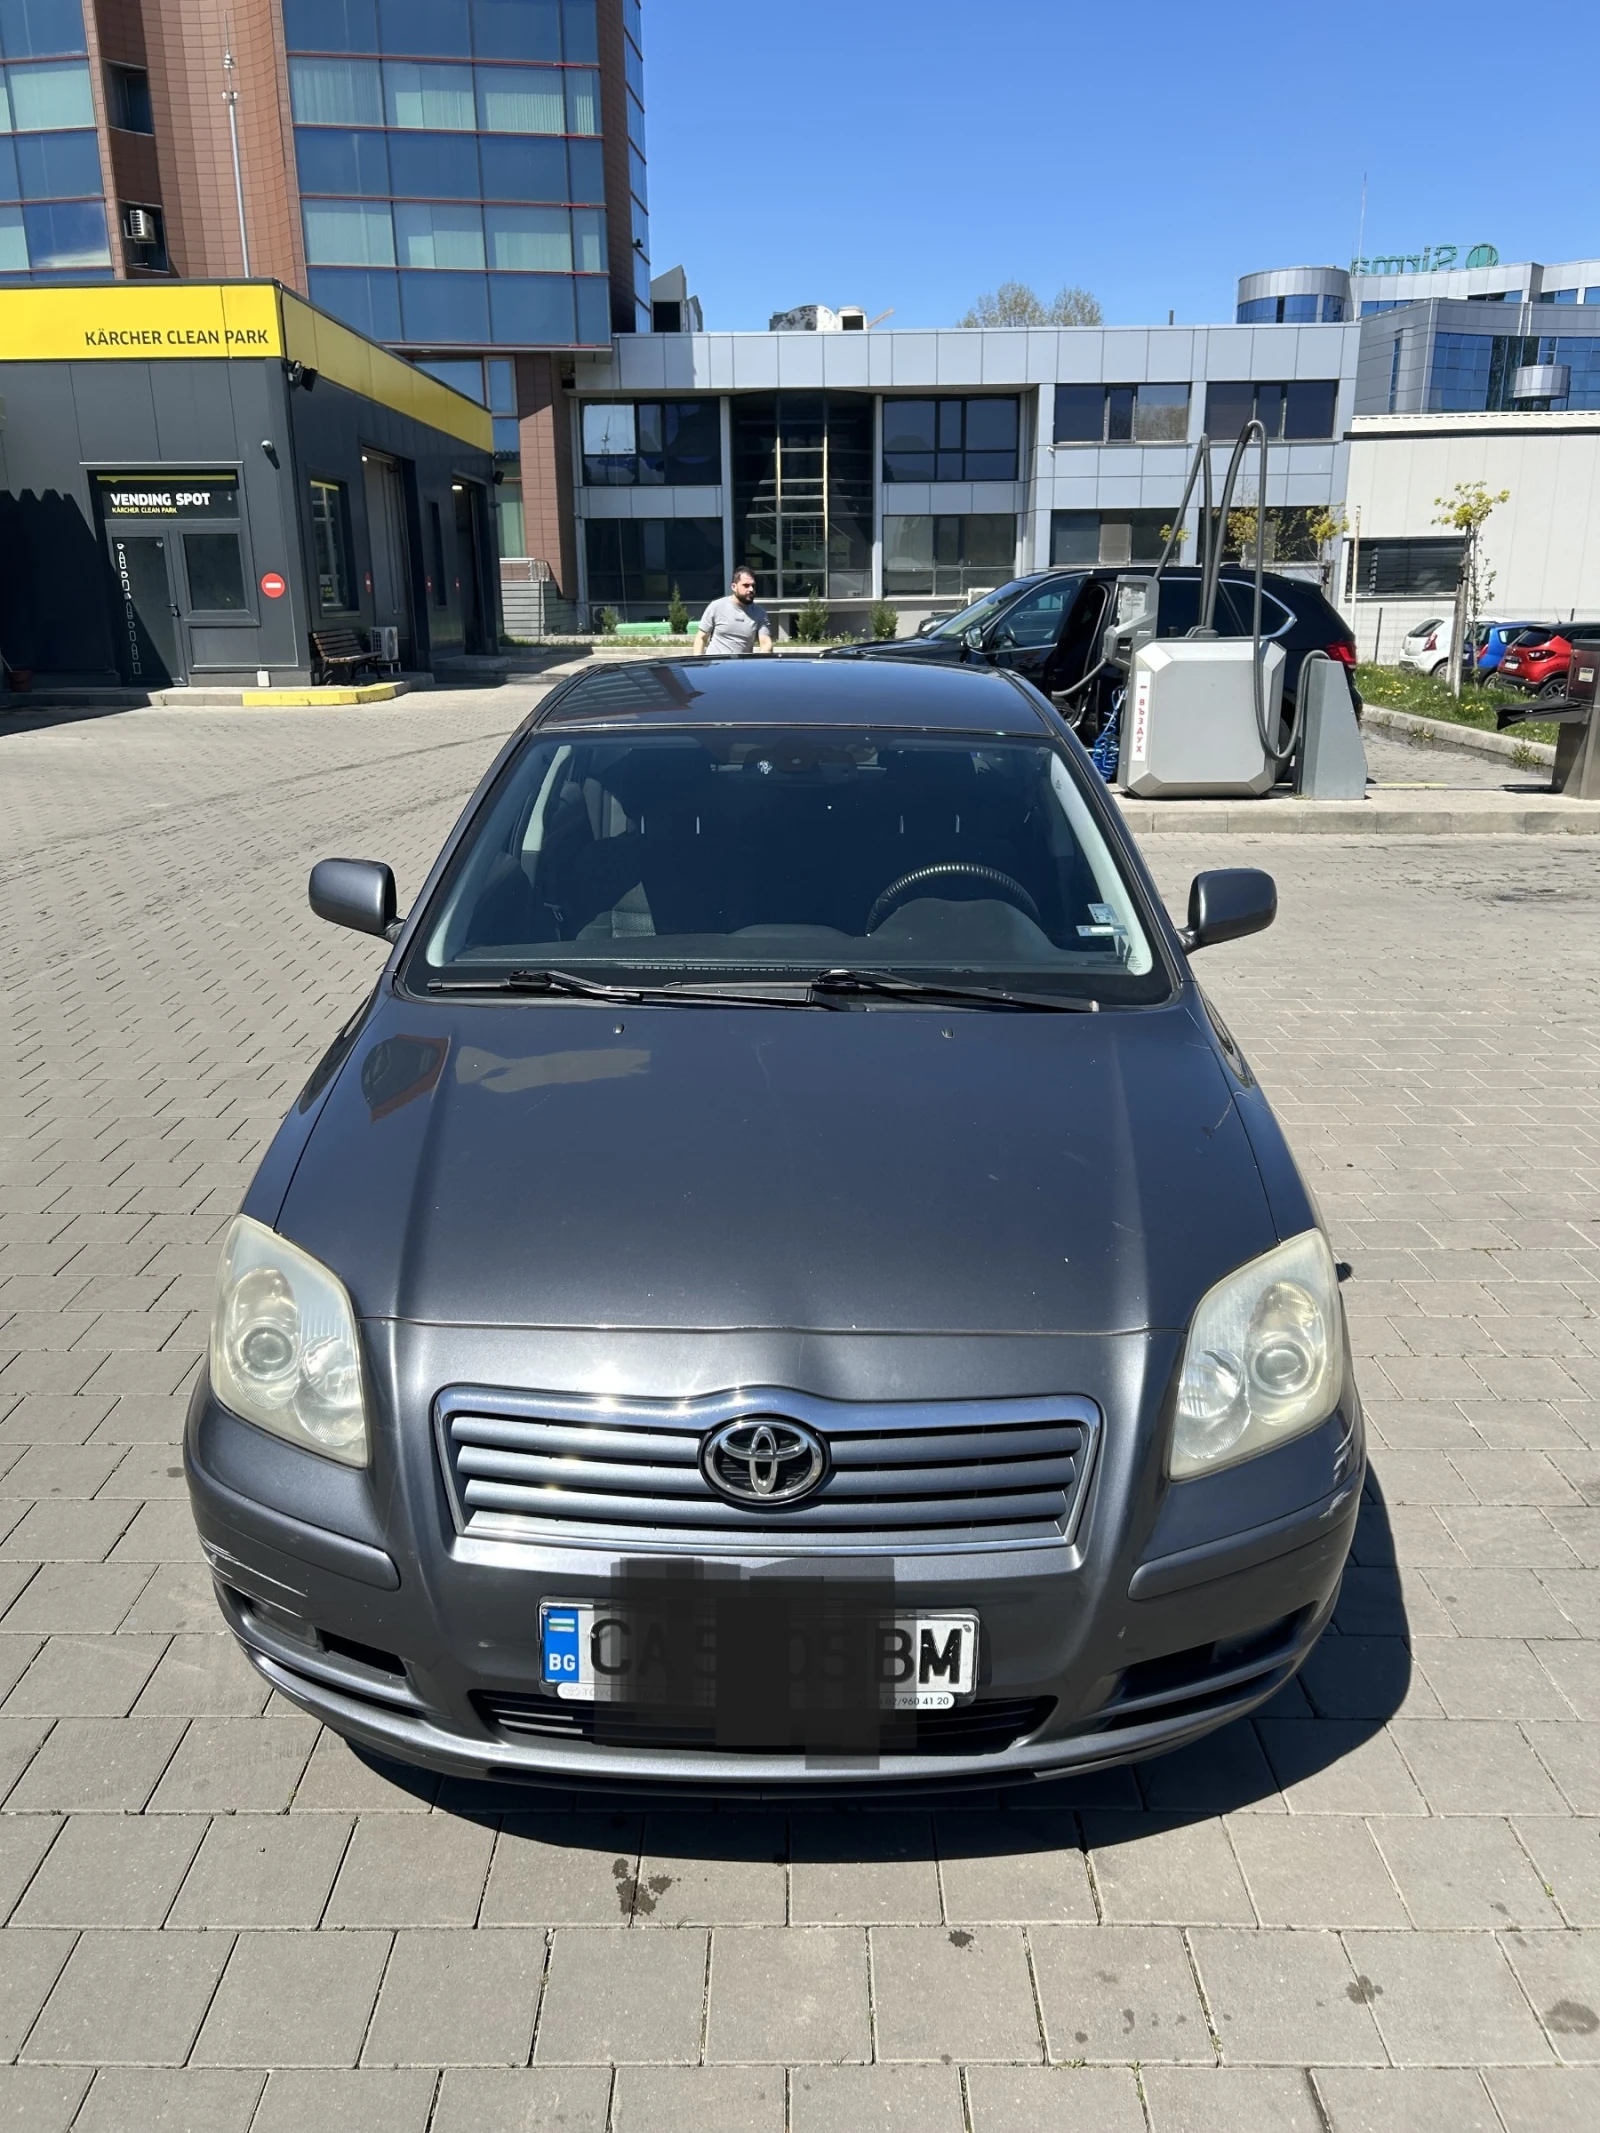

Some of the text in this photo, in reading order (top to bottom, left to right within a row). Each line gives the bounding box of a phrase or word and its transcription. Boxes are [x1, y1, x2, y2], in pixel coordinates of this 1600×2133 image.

[84, 328, 269, 346] KÄRCHER CLEAN PARK
[110, 493, 210, 506] VENDING SPOT
[140, 506, 160, 514] CLEAN
[161, 506, 178, 514] PARK
[549, 1653, 576, 1672] BG
[922, 1696, 934, 1705] 41
[937, 1696, 950, 1705] 20
